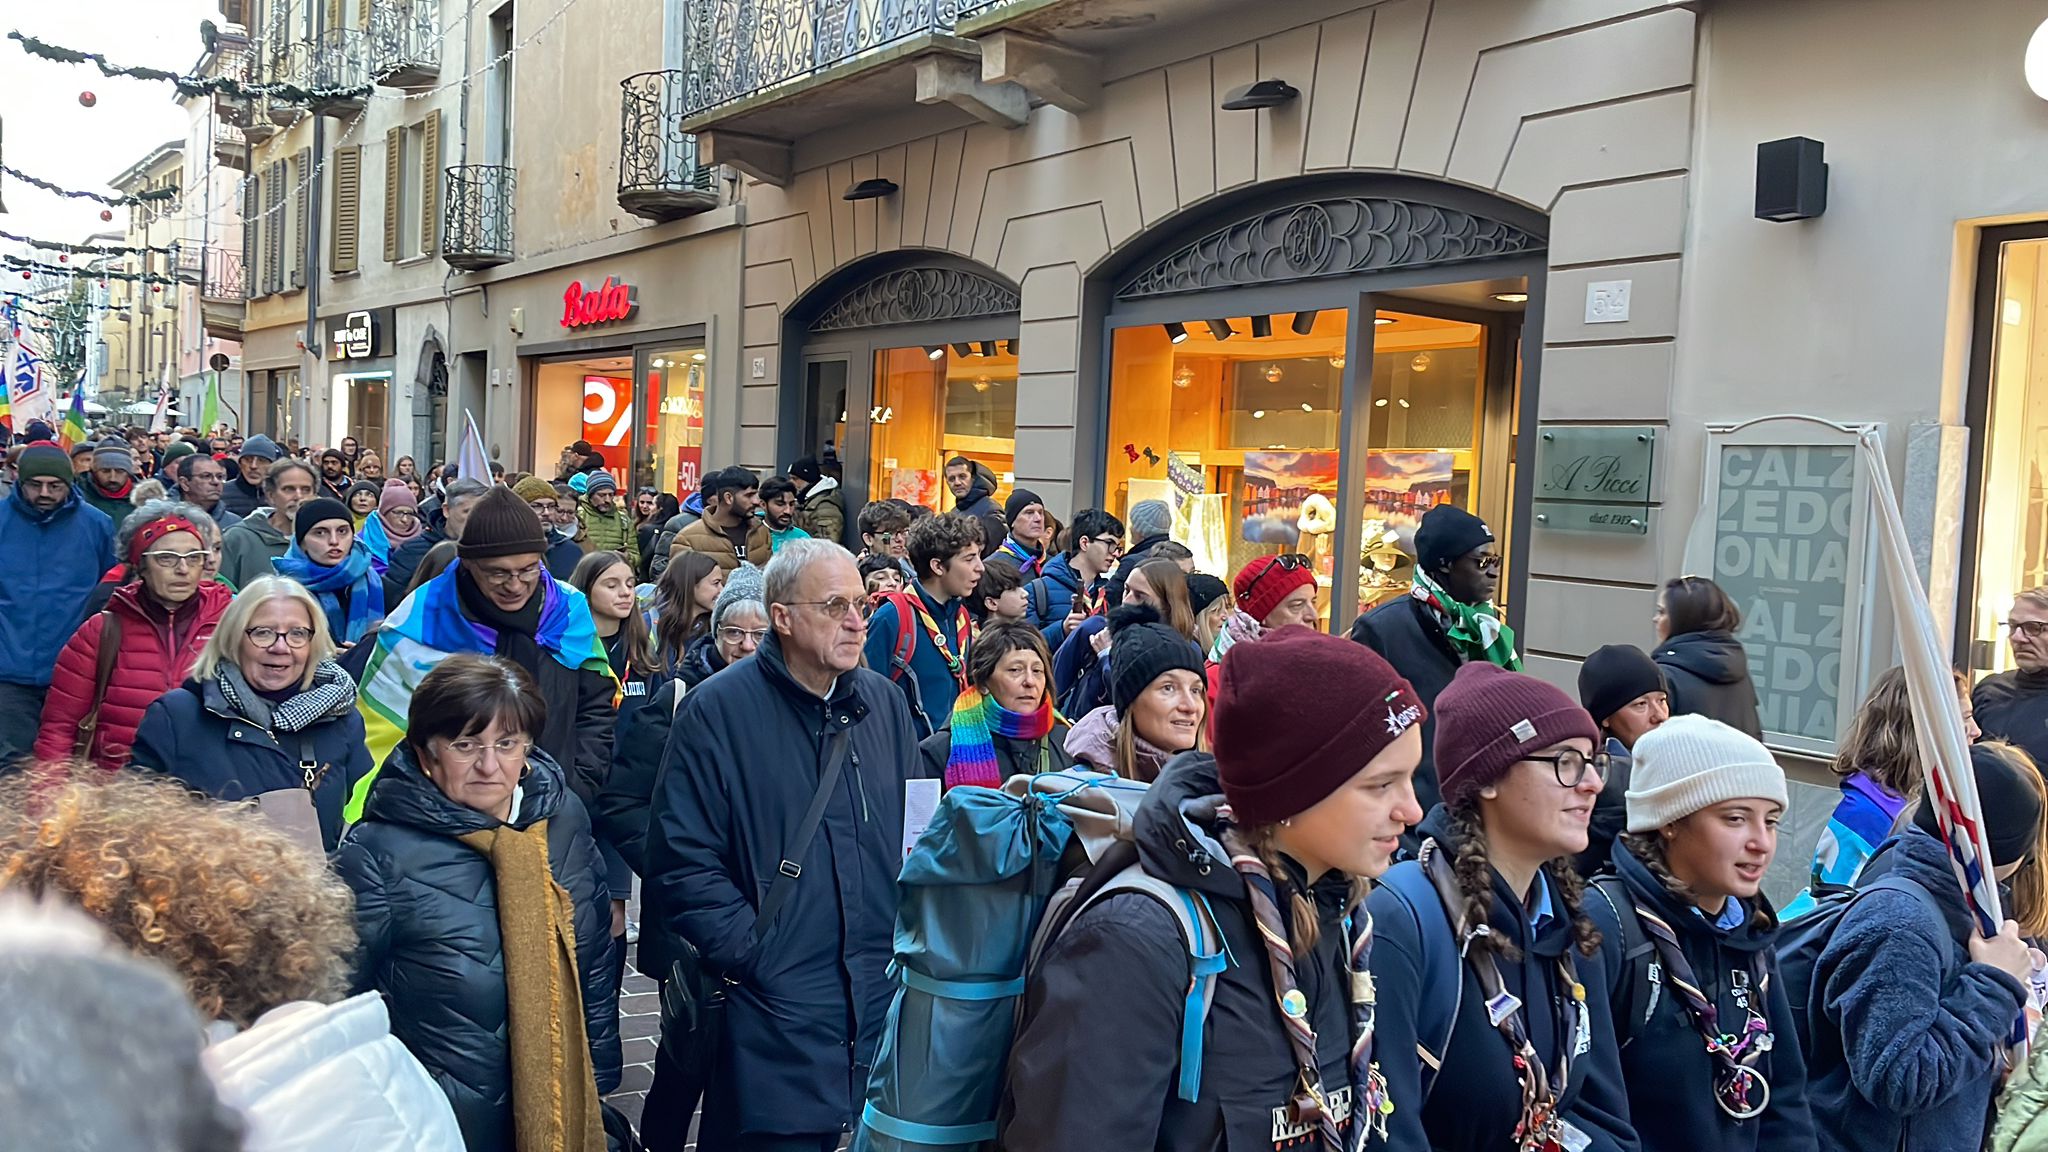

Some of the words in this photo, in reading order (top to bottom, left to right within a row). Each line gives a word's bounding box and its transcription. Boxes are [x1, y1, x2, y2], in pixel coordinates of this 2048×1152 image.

[560, 275, 630, 328] Bata
[1583, 455, 1642, 494] Picci
[1720, 446, 1854, 488] CALZ
[1715, 535, 1848, 584] ONIA
[1731, 595, 1843, 649] ALZ
[1743, 641, 1841, 698] EDO
[1755, 691, 1836, 742] NIA
